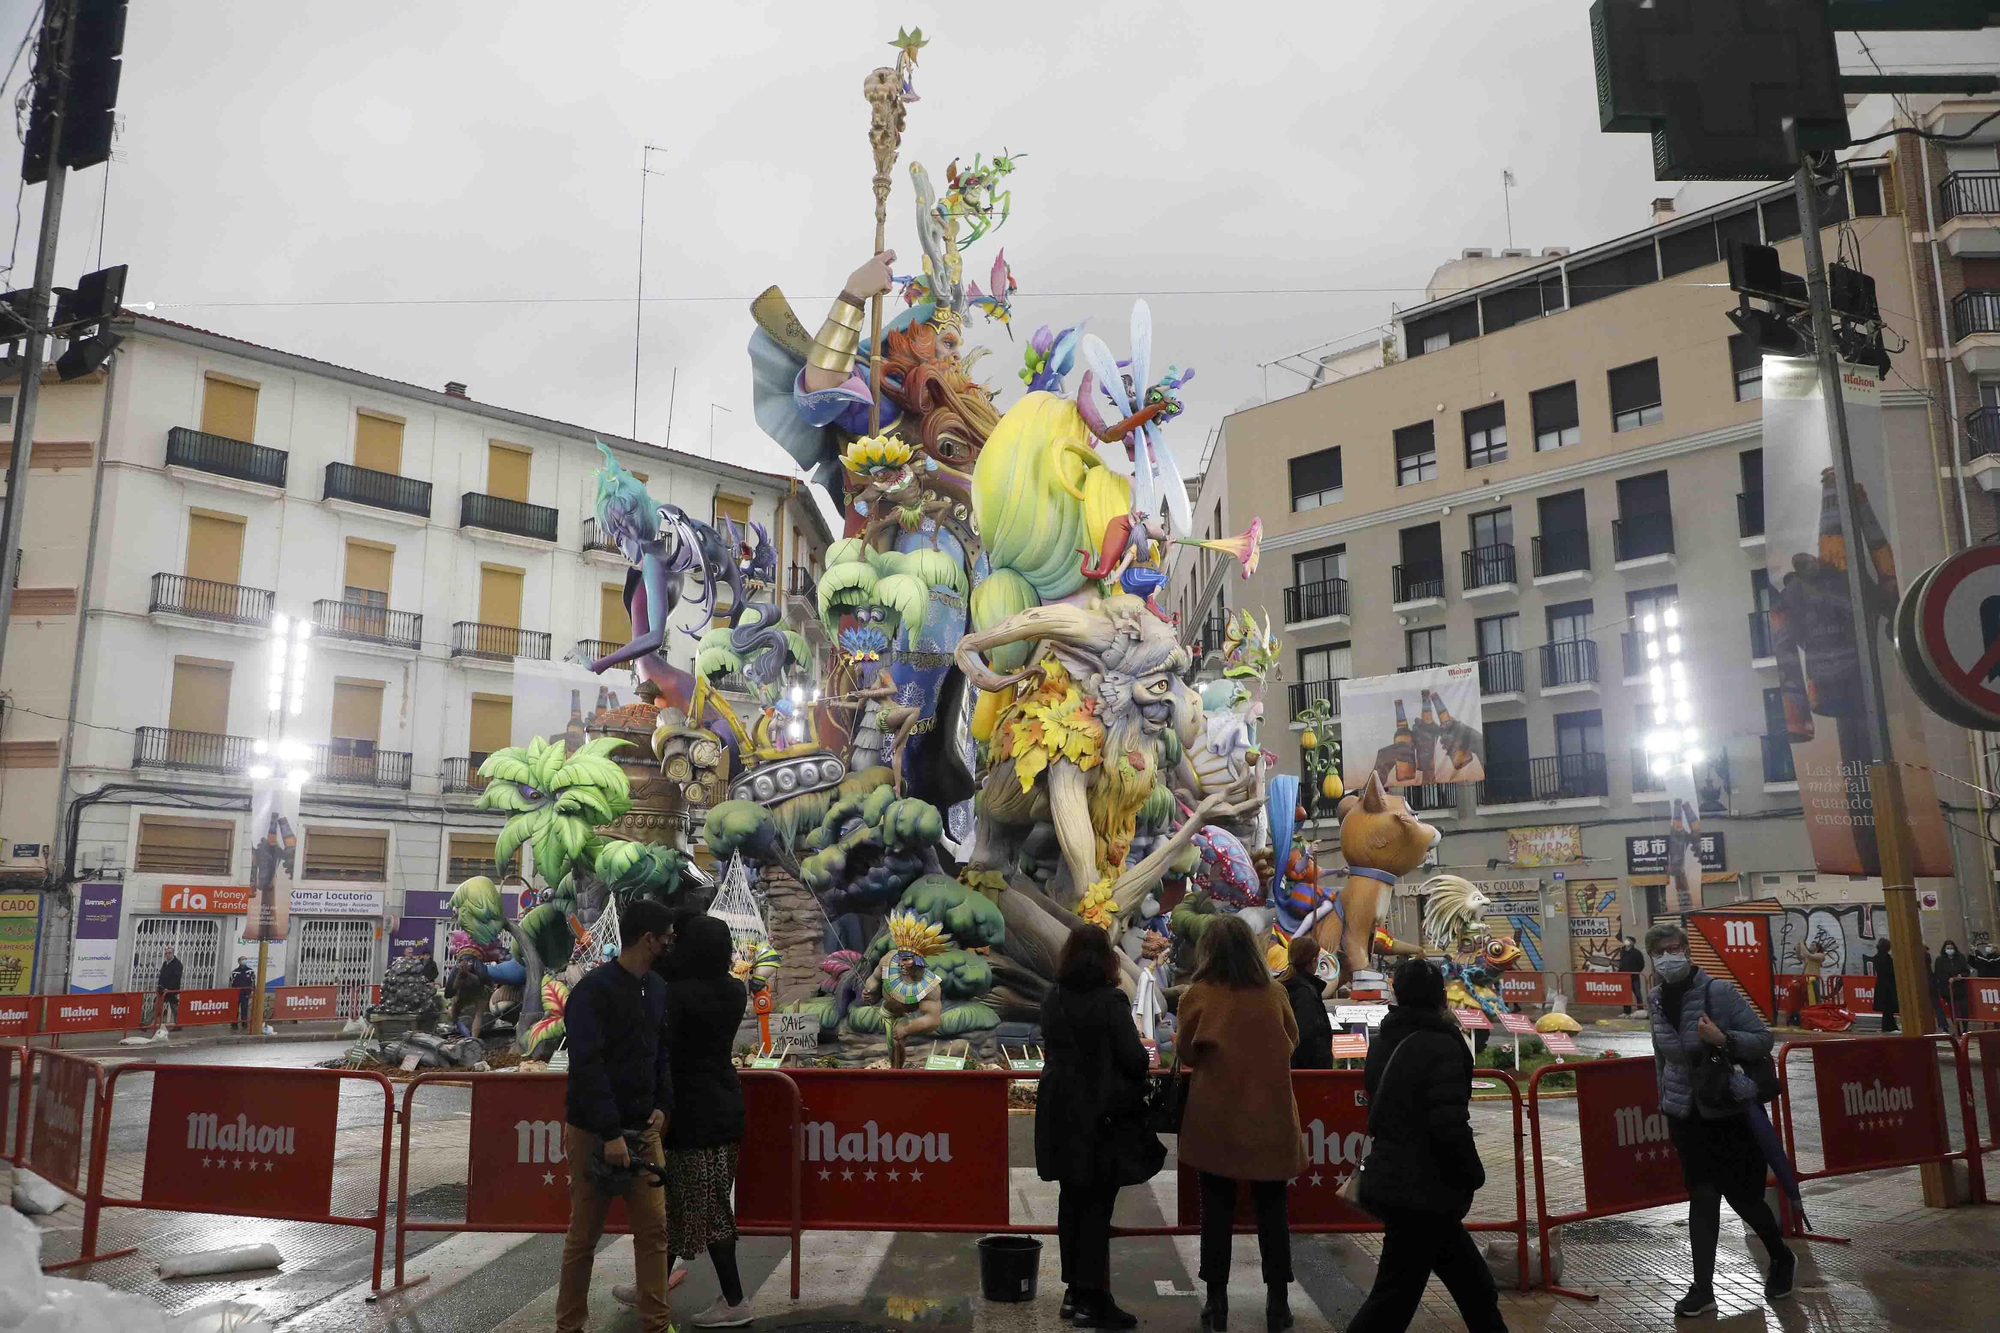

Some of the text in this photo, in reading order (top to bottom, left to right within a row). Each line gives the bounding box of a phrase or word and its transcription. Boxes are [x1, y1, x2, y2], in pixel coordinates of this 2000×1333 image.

[1843, 374, 1875, 388] Mahou
[1447, 667, 1472, 677] Mahou
[1805, 760, 1872, 776] Las falla
[1809, 777, 1872, 793] más fall
[1812, 794, 1873, 810] cuando
[1493, 880, 1525, 890] COLOR
[170, 887, 247, 910] ria Money
[290, 890, 373, 901] Kumar Locutorio
[212, 901, 248, 910] Transfe
[1570, 919, 1596, 927] VENTA
[1571, 928, 1608, 936] PETARDOS
[1585, 981, 1622, 992] Mahou
[190, 1000, 229, 1011] Mahou
[286, 995, 327, 1007] Mahou
[60, 1005, 99, 1017] Mahou
[780, 1015, 806, 1033] SAVE
[1841, 1078, 1914, 1116] Mahou
[187, 1112, 296, 1155] Mahou
[789, 1120, 954, 1163] Mahou
